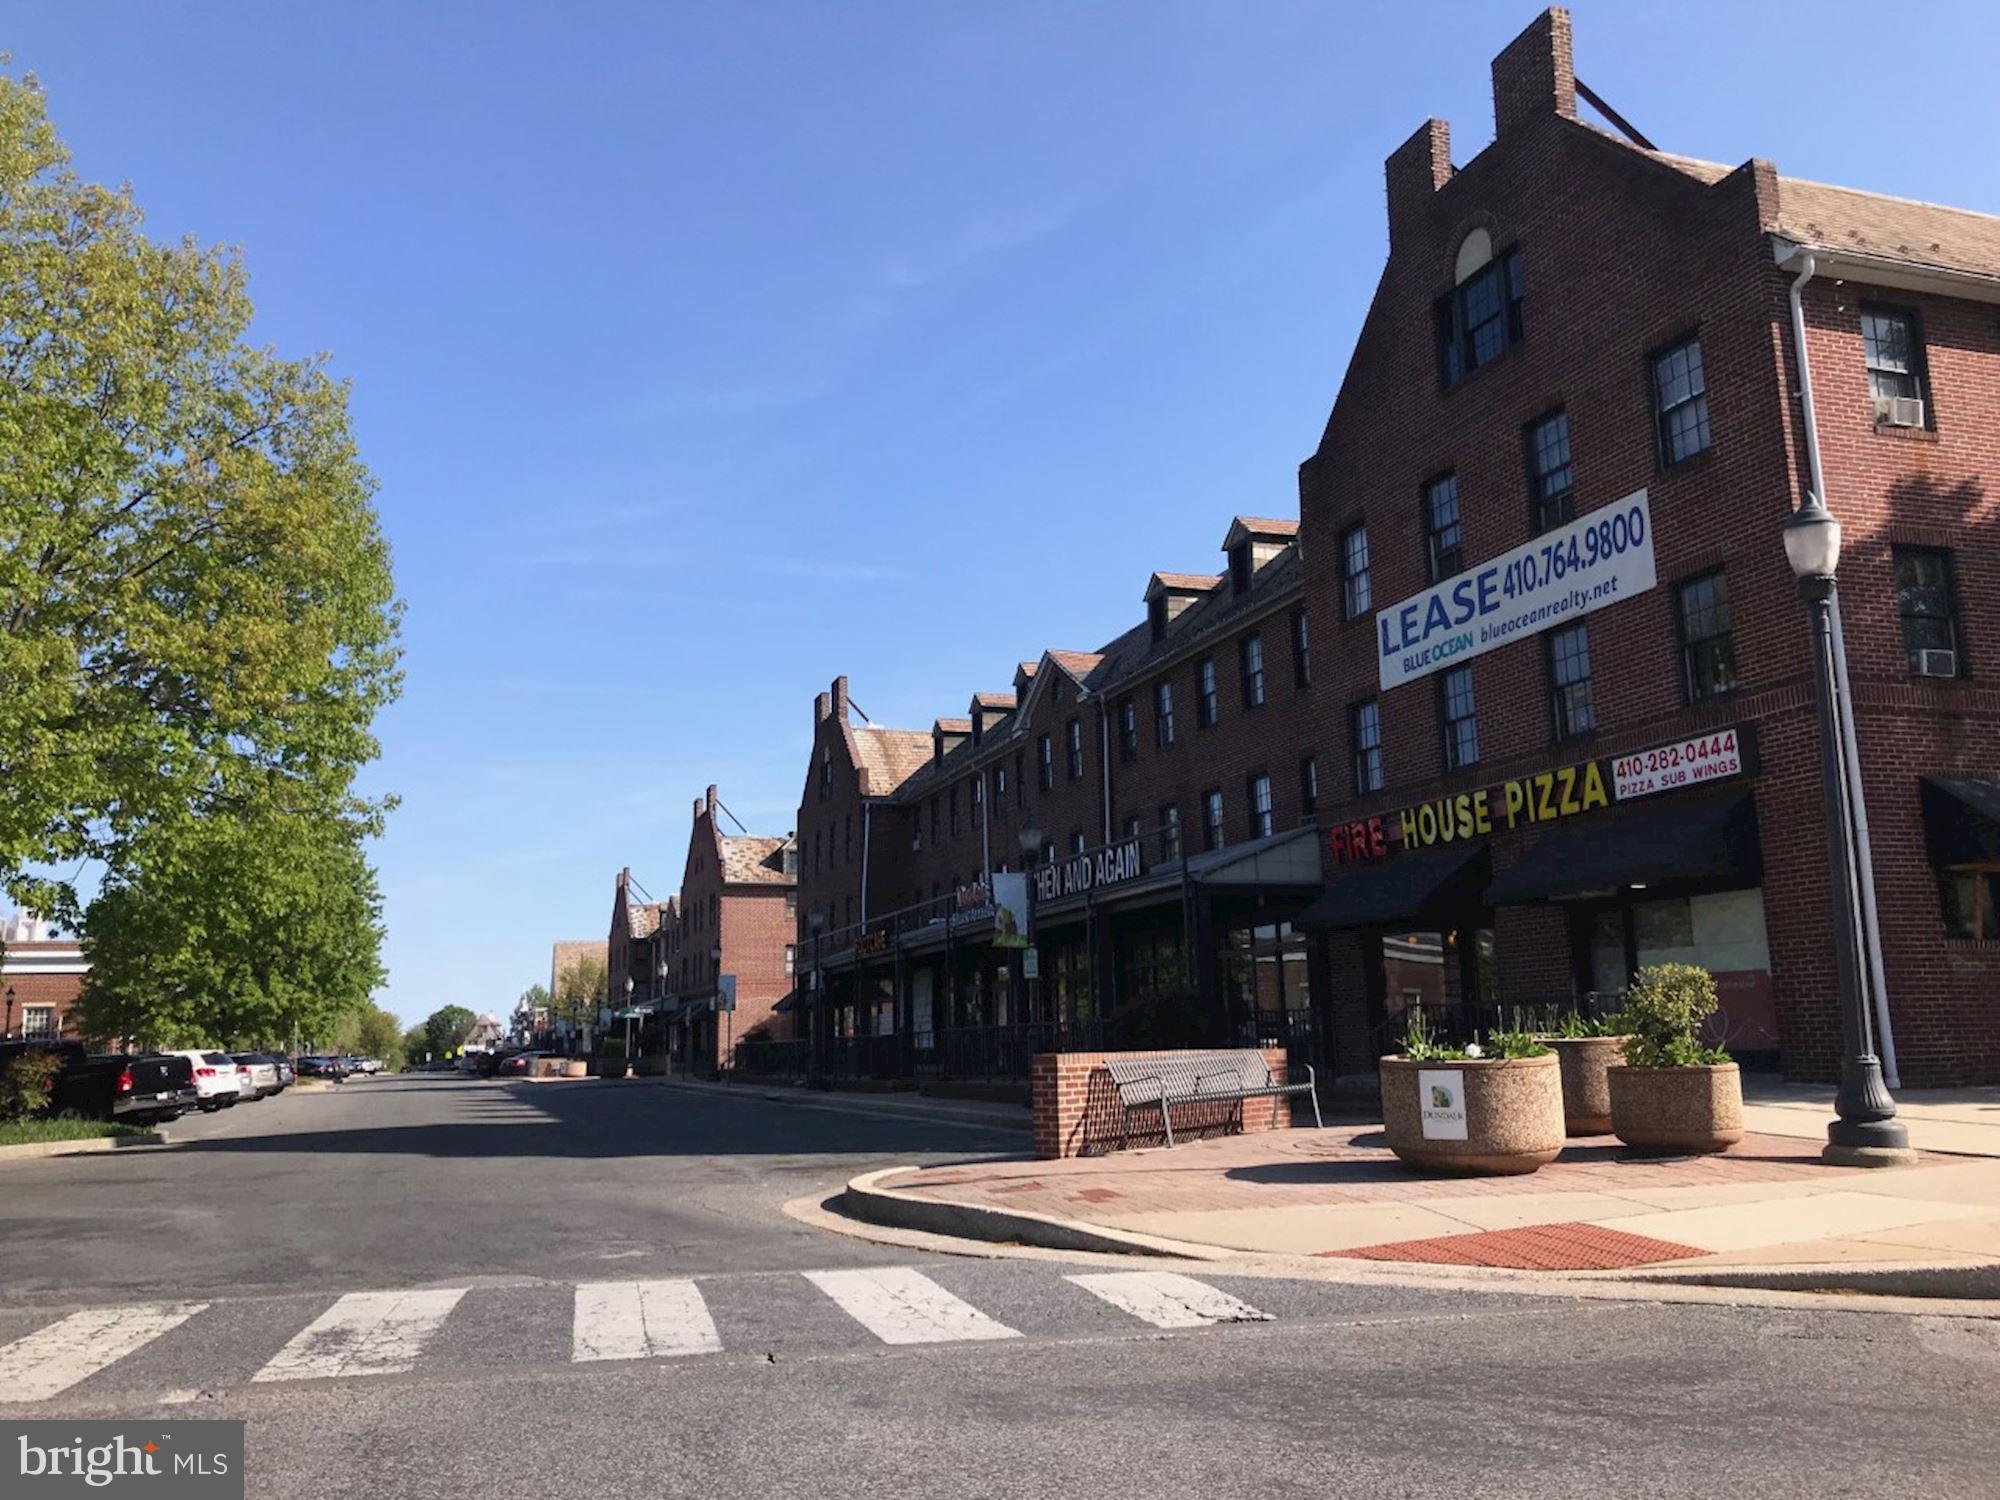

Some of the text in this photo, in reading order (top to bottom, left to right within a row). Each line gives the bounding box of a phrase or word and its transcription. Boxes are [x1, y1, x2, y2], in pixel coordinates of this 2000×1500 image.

[1380, 506, 1645, 657] LEASE 410.764.9800
[1403, 575, 1618, 673] BLUE OCEAN blueoceanrealty.net
[1616, 732, 1736, 779] 410-282-0444
[1619, 757, 1738, 796] PIZZA SUB WINGS
[1330, 762, 1608, 864] FIRE HOUSE PIZZA
[1034, 865, 1061, 901] HEN
[1063, 856, 1092, 894] AND
[1095, 840, 1140, 887] AGAIN
